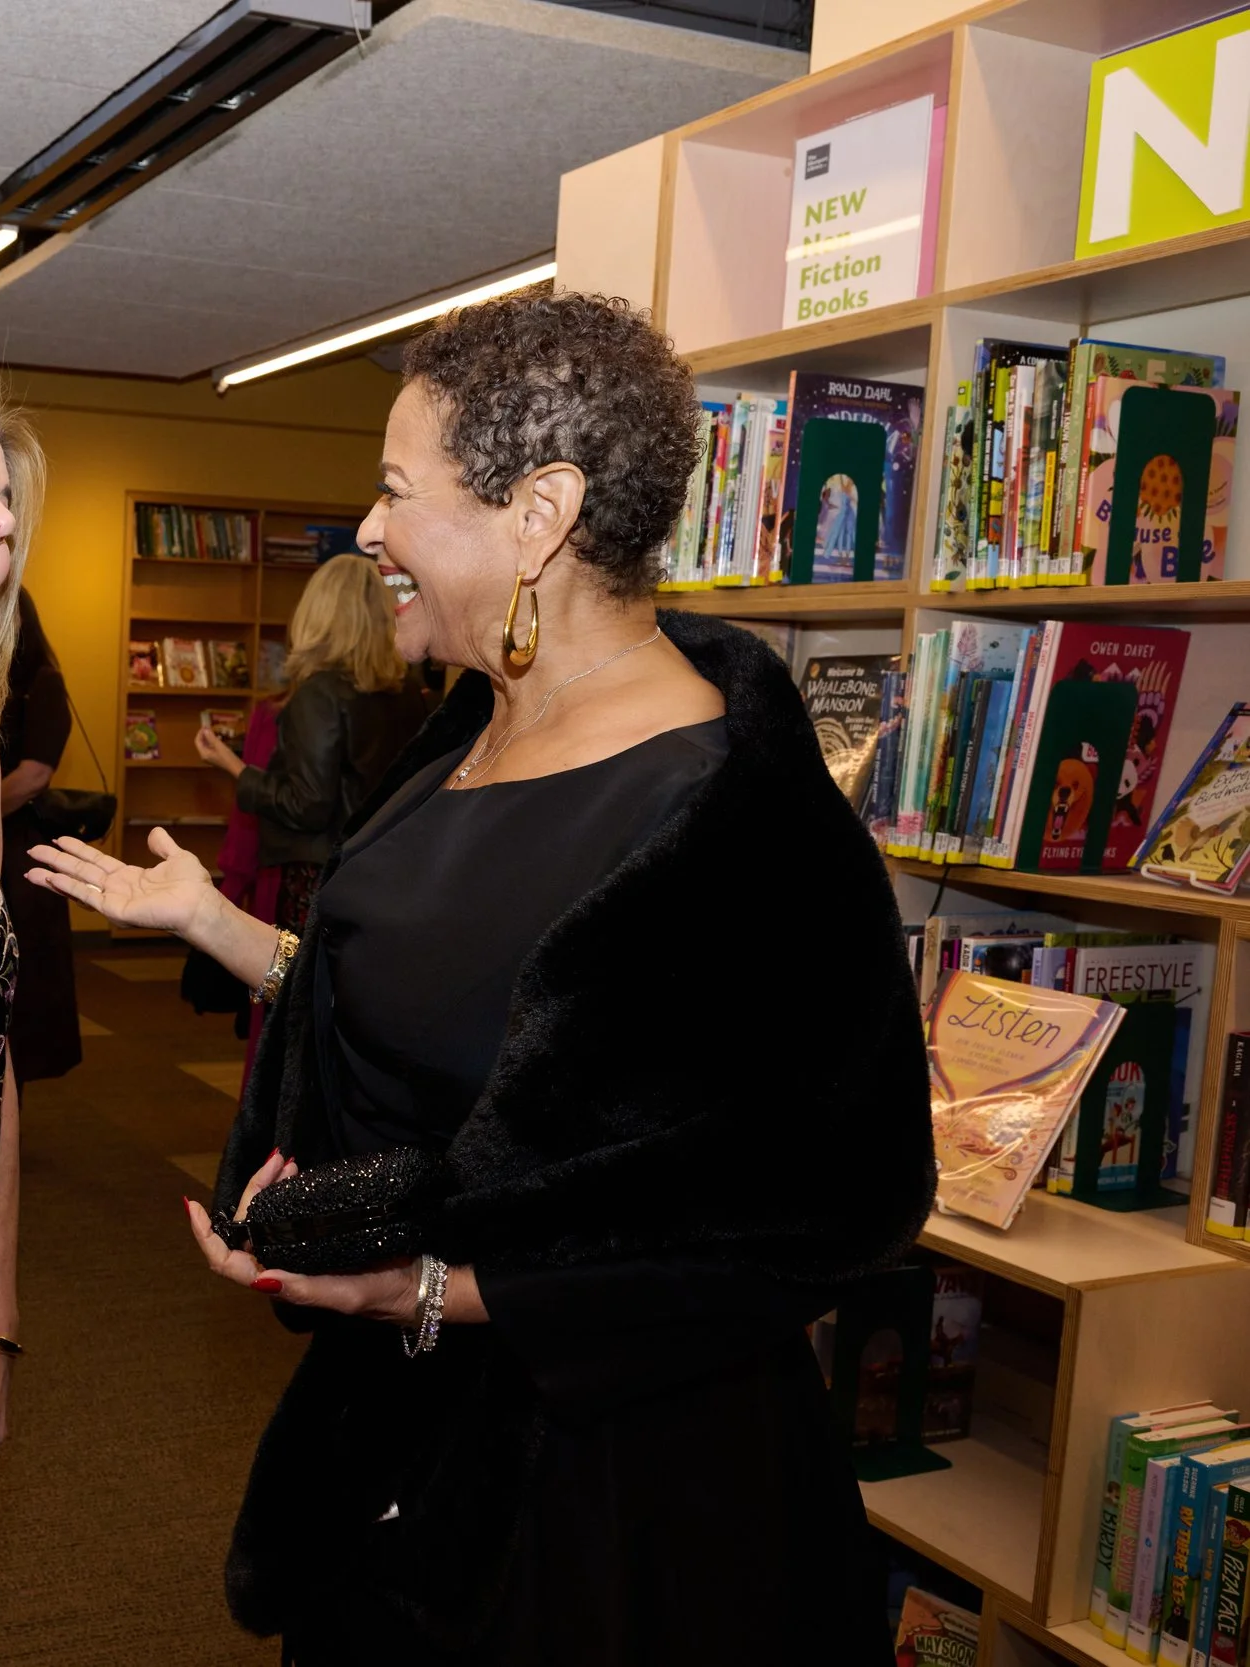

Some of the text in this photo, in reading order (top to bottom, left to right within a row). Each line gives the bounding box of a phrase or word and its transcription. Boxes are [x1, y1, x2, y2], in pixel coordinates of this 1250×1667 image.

[805, 187, 867, 227] NEW
[800, 255, 882, 290] Fiction
[797, 287, 869, 321] Books
[828, 381, 893, 402] ROALD DAHL
[1090, 641, 1155, 658] OWEN DAVEY
[807, 678, 878, 699] WHALEBONE
[810, 697, 866, 714] MANSION
[1042, 846, 1070, 858] FLYING
[1085, 962, 1194, 993] FREESTYLE
[947, 991, 1061, 1048] Listen
[1232, 1041, 1245, 1077] KAGAWA
[1178, 1505, 1195, 1528] RV
[1098, 1509, 1118, 1573] BIRDY
[1173, 1529, 1191, 1570] THERE
[1216, 1552, 1245, 1636] PIZZA FACE
[916, 1636, 975, 1666] MAYSOON
